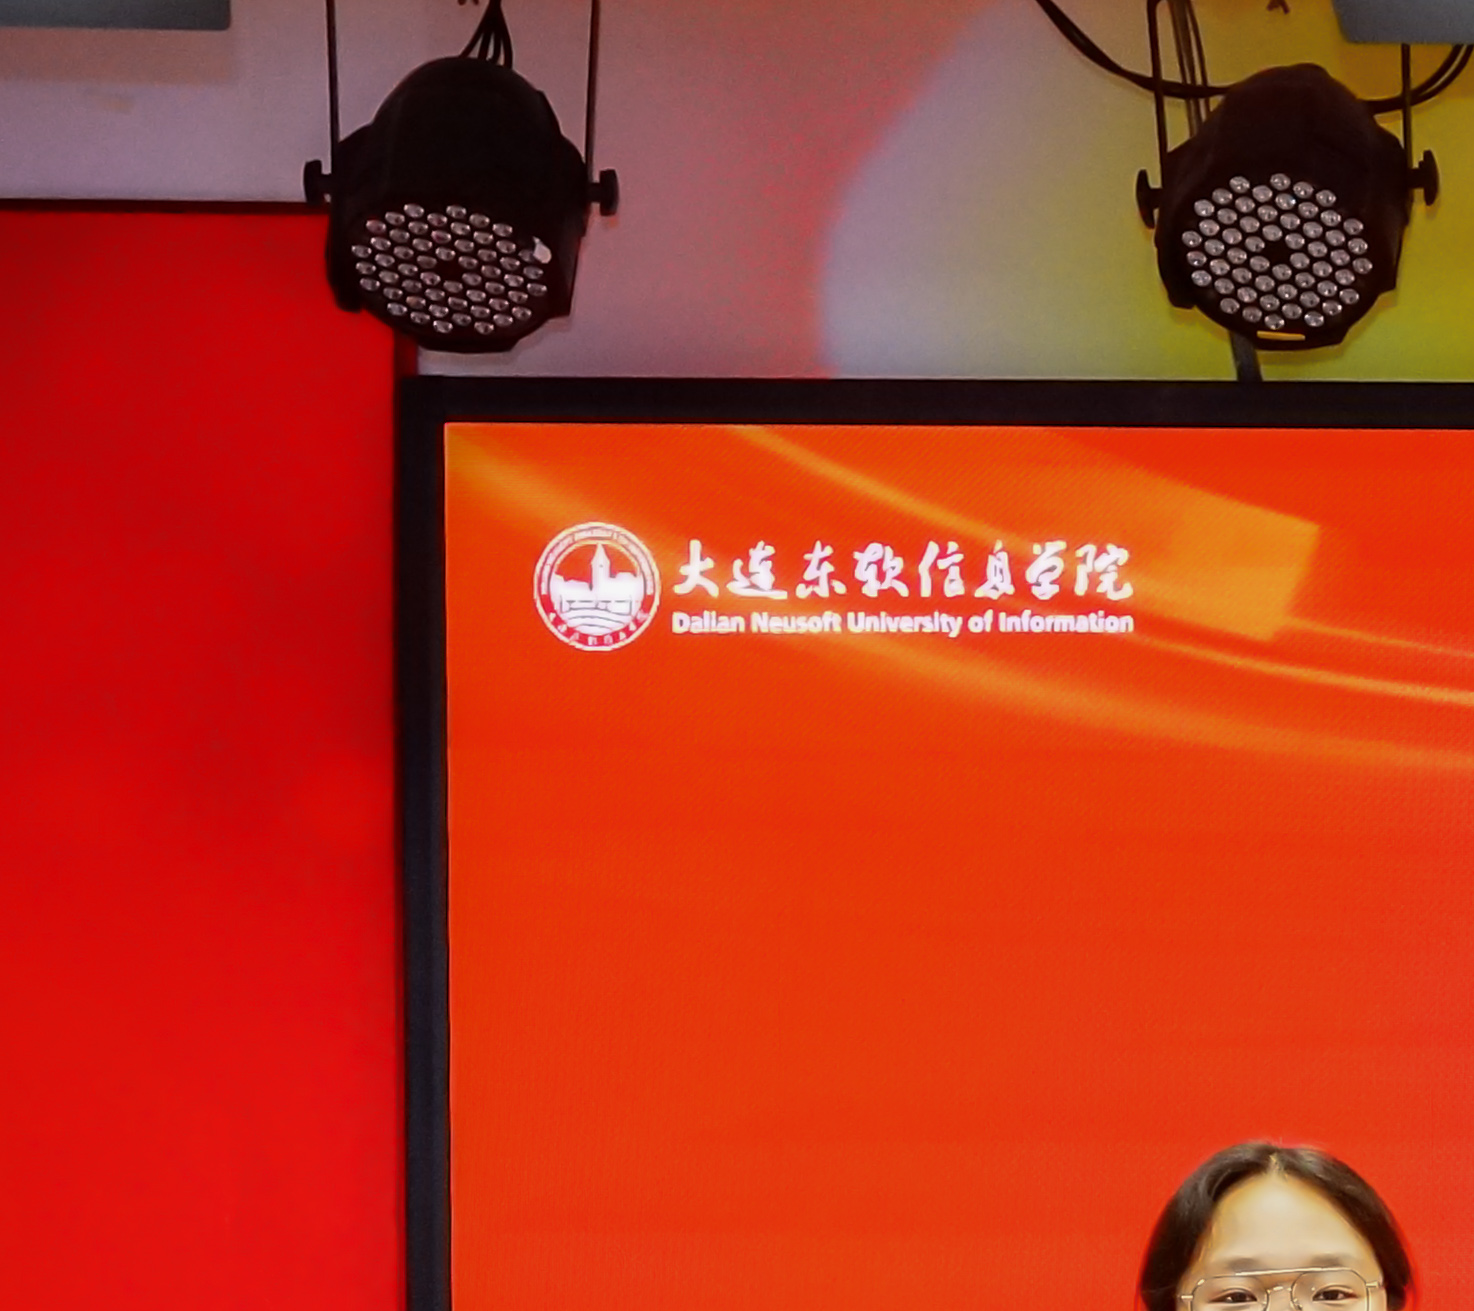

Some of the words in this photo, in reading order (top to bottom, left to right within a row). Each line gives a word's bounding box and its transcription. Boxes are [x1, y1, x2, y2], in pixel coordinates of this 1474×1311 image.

[673, 539, 1134, 600] 大连东软信息学院
[672, 610, 745, 633] Dalian
[751, 611, 842, 633] Neusoft
[847, 610, 963, 638] University
[968, 609, 993, 633] of
[998, 609, 1134, 633] Information
